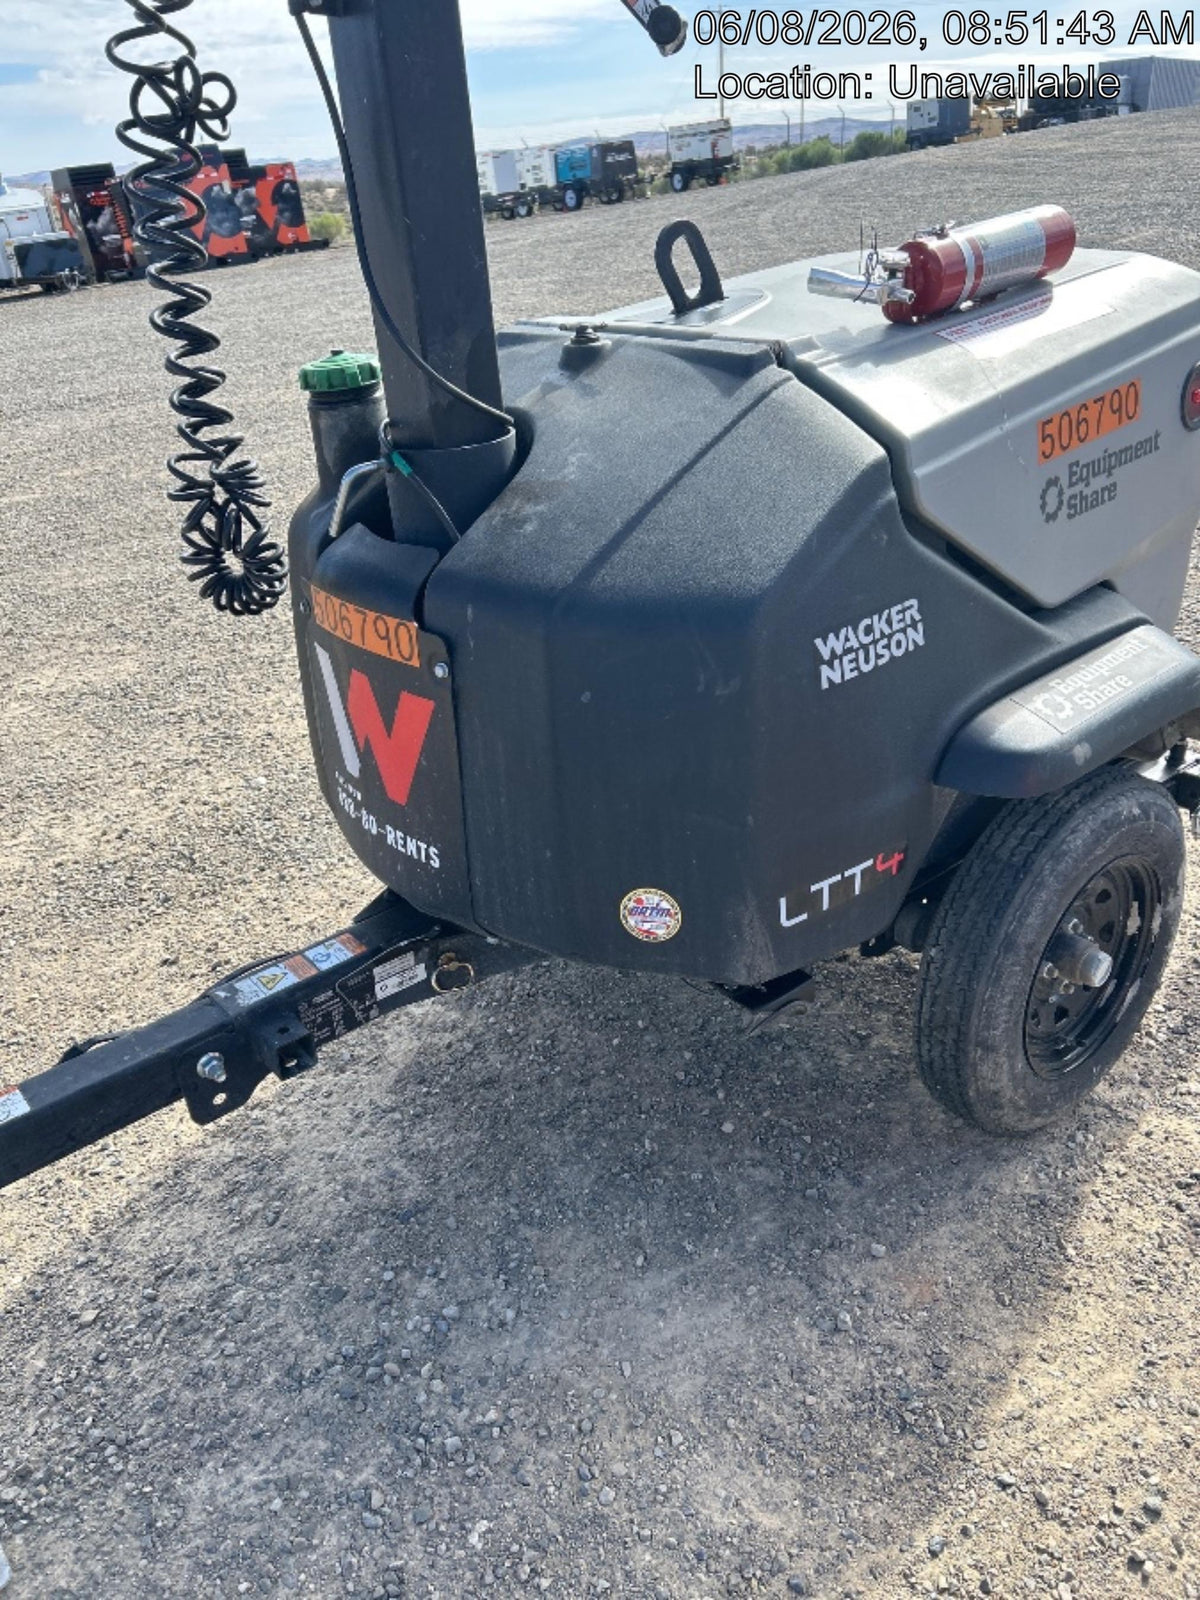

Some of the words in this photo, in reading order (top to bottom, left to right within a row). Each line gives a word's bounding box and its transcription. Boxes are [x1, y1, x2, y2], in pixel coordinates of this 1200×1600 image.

[1041, 381, 1139, 460] 506790
[1067, 428, 1161, 489] Equipment
[1066, 481, 1117, 520] Share
[313, 588, 414, 662] 506790
[814, 598, 922, 661] WACKER
[820, 622, 925, 690] NEUSON
[1048, 640, 1149, 694] Equipment
[1073, 675, 1134, 710] Share
